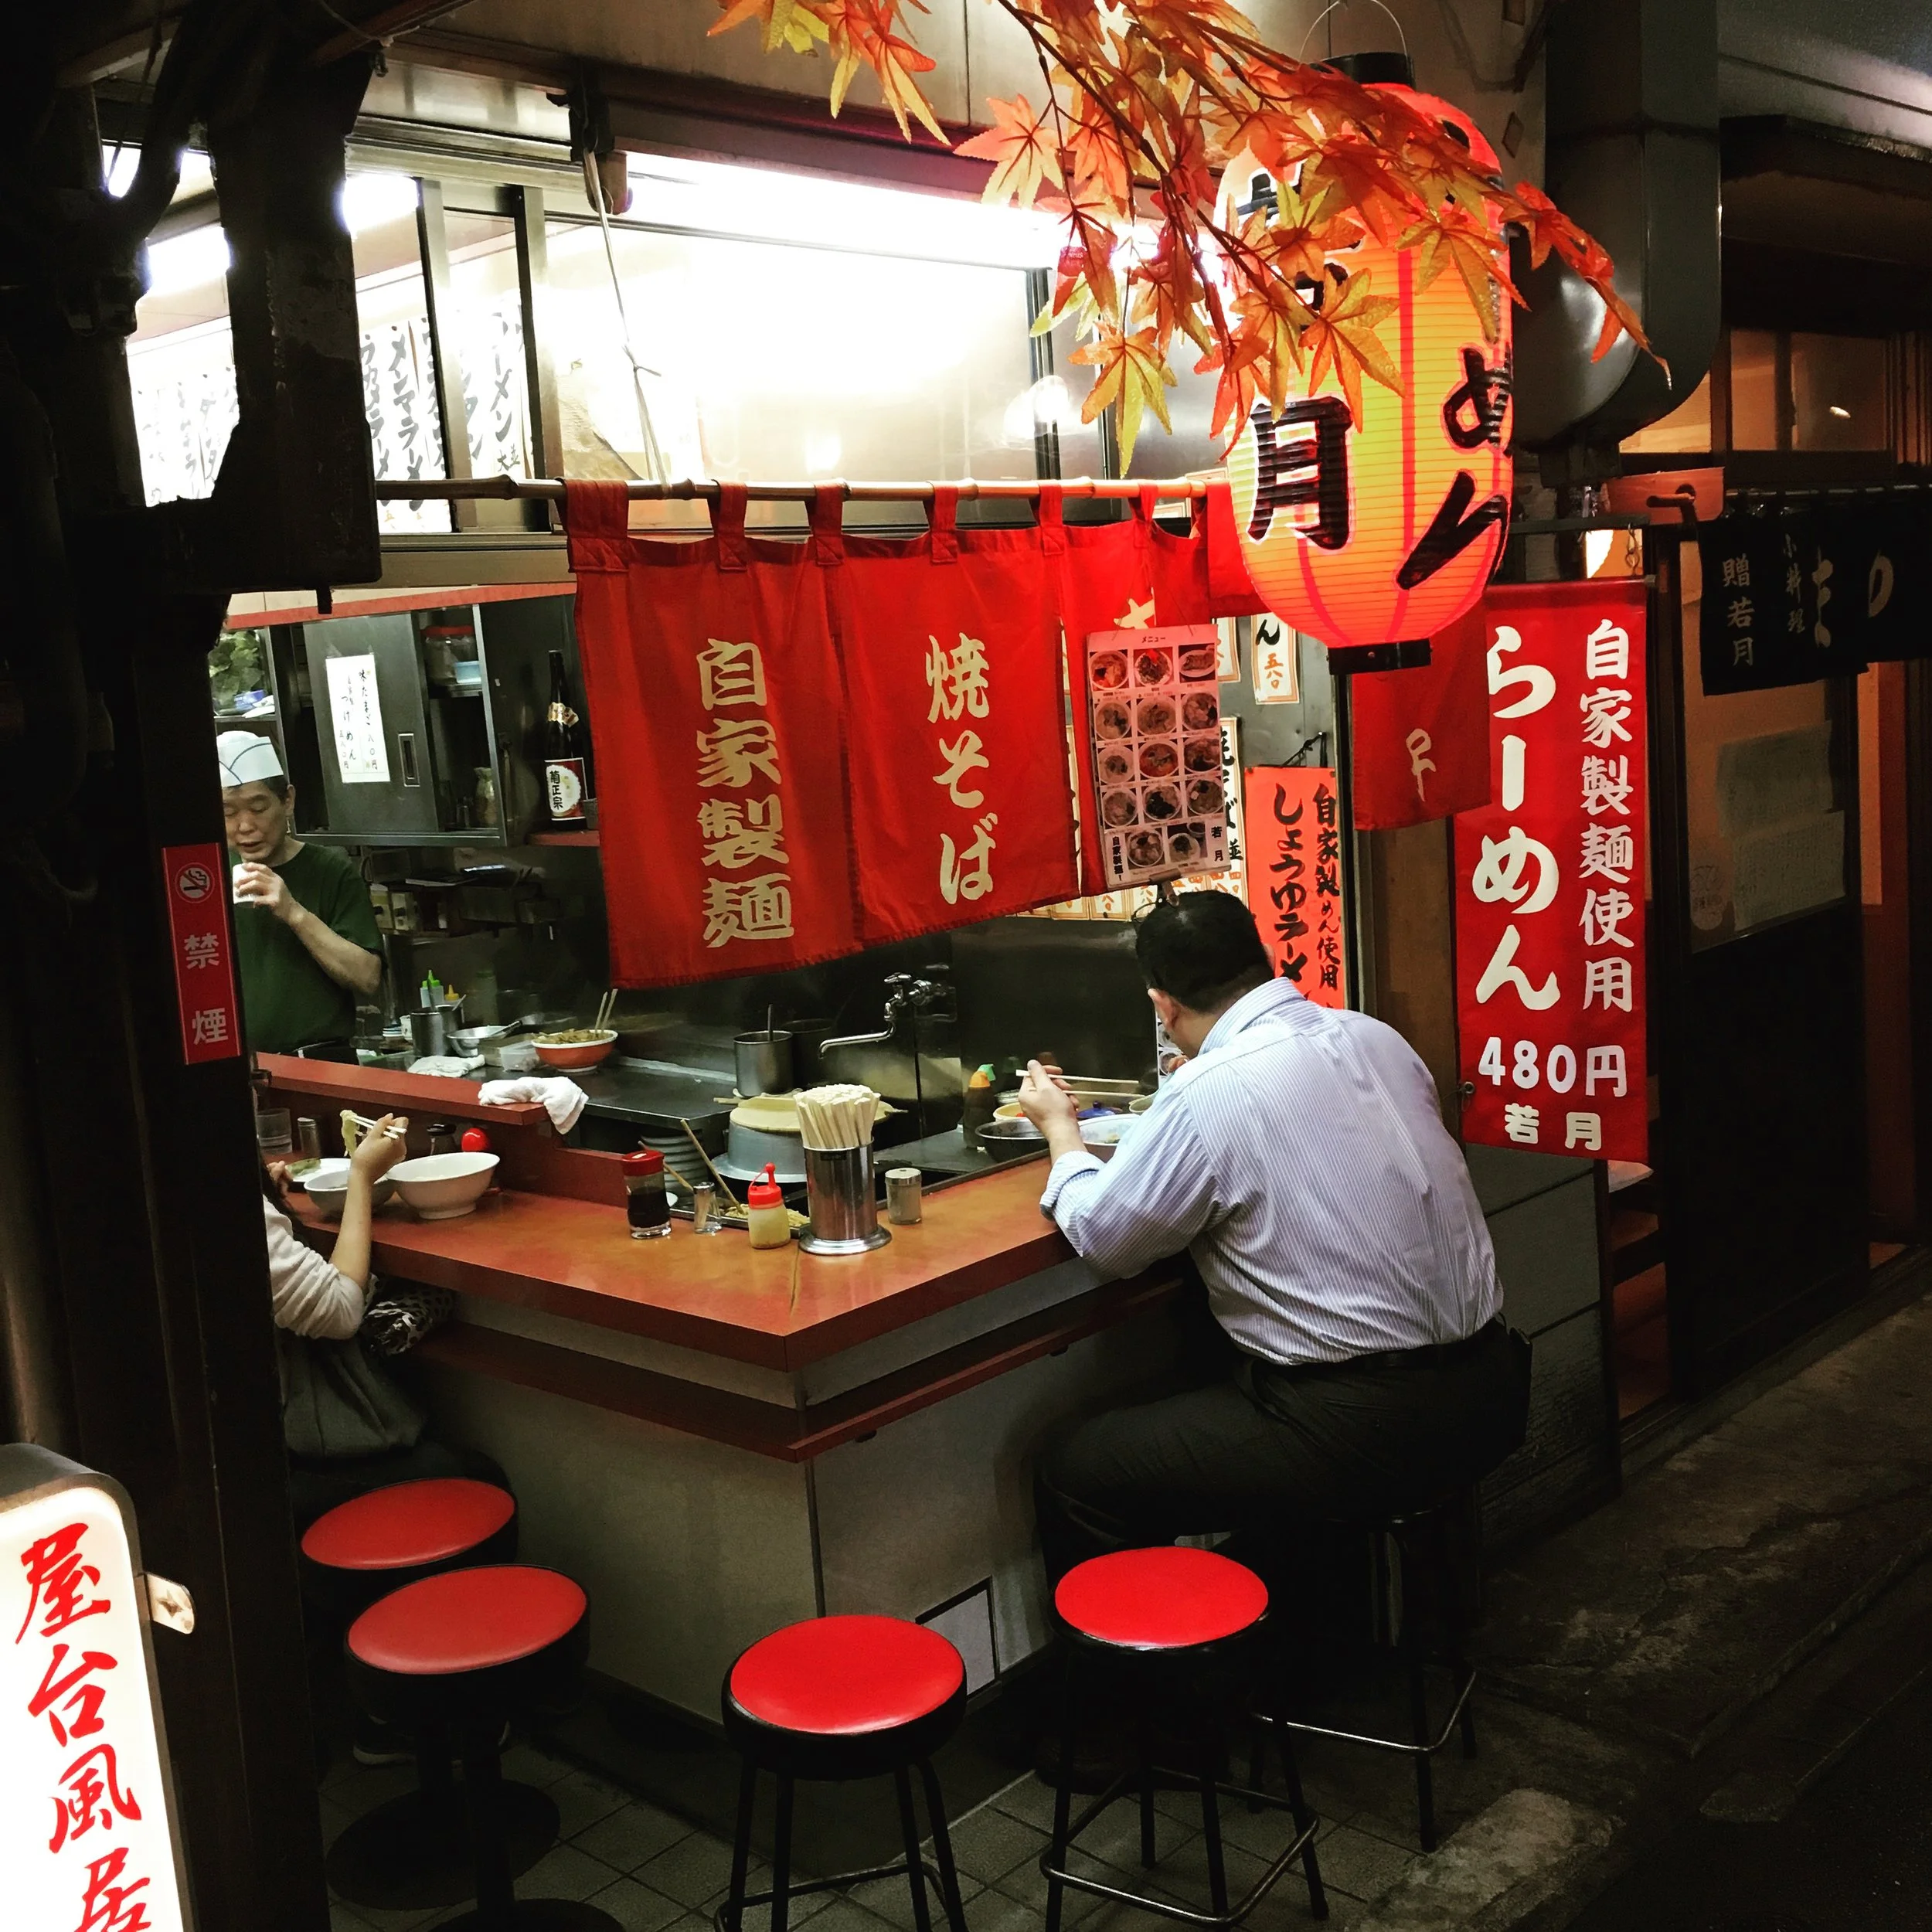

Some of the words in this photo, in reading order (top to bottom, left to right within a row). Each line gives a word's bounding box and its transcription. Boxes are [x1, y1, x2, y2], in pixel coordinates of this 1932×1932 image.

[341, 696, 356, 760] つけめん
[925, 632, 999, 905] 焼そば
[549, 770, 563, 810] 菊正宗
[696, 638, 794, 947] 自家製麺
[1211, 826, 1224, 862] 若月
[1472, 625, 1560, 1012] らーめん
[1578, 619, 1634, 1012] 自家製麺使用
[1270, 783, 1311, 1000] しょうゆラーメ
[184, 932, 229, 1045] 禁煙
[1478, 1036, 1627, 1097] 480円
[1504, 1102, 1602, 1151] 若月
